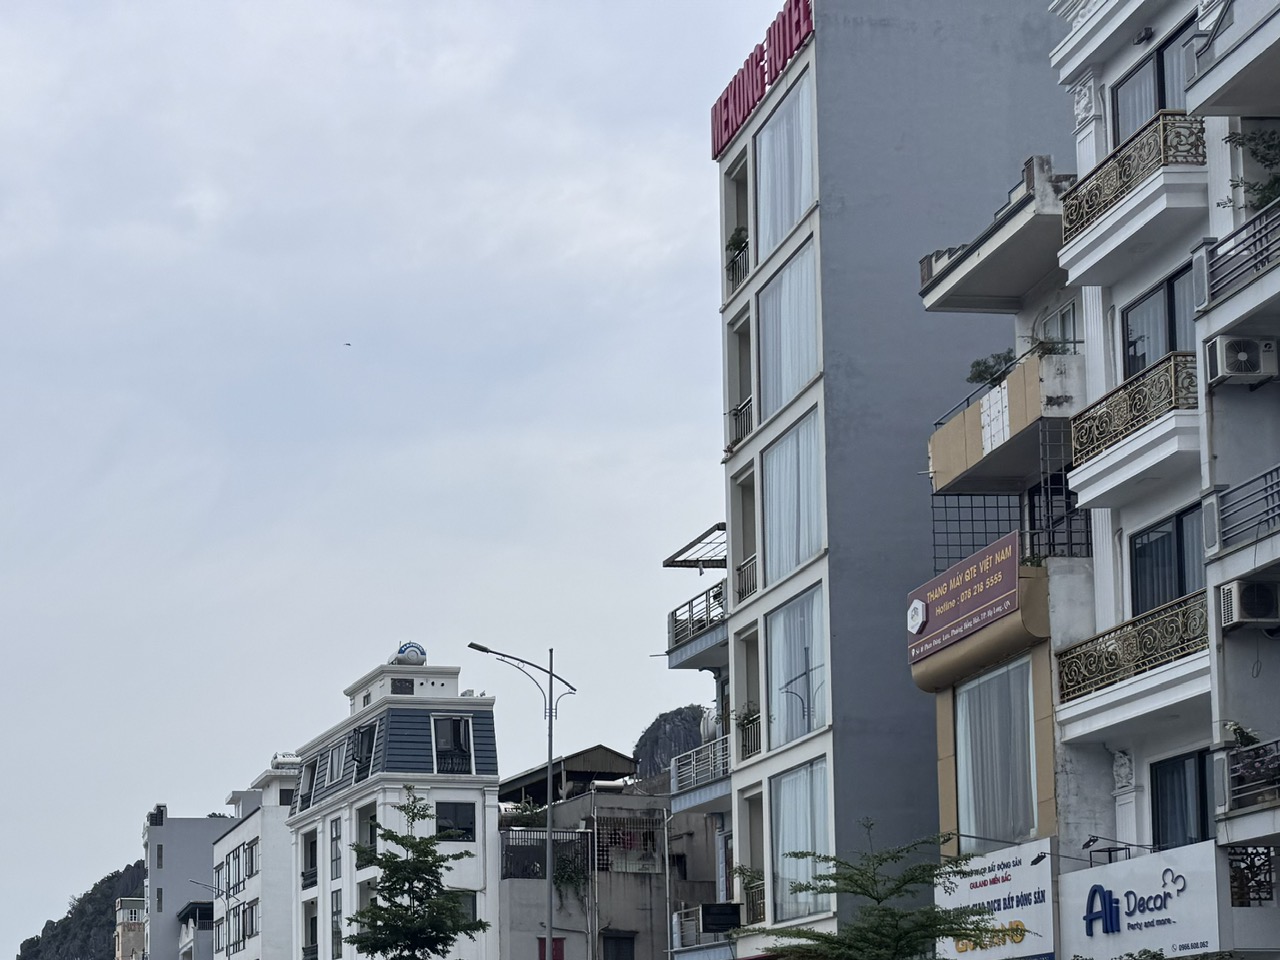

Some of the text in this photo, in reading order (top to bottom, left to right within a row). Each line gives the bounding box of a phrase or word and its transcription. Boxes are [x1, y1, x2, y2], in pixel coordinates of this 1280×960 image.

[711, 43, 766, 160] MEKONG
[926, 545, 1012, 603] THANG MÁY QTE VIỆT NAM
[935, 598, 956, 616] Hotline
[972, 581, 984, 596] 218
[1002, 891, 1015, 911] BẤT
[1016, 891, 1032, 910] ĐỘNG
[1033, 887, 1046, 905] SẢN
[1082, 884, 1173, 937] Ali Decor
[955, 920, 1026, 953] GUAND
[1144, 918, 1155, 928] and
